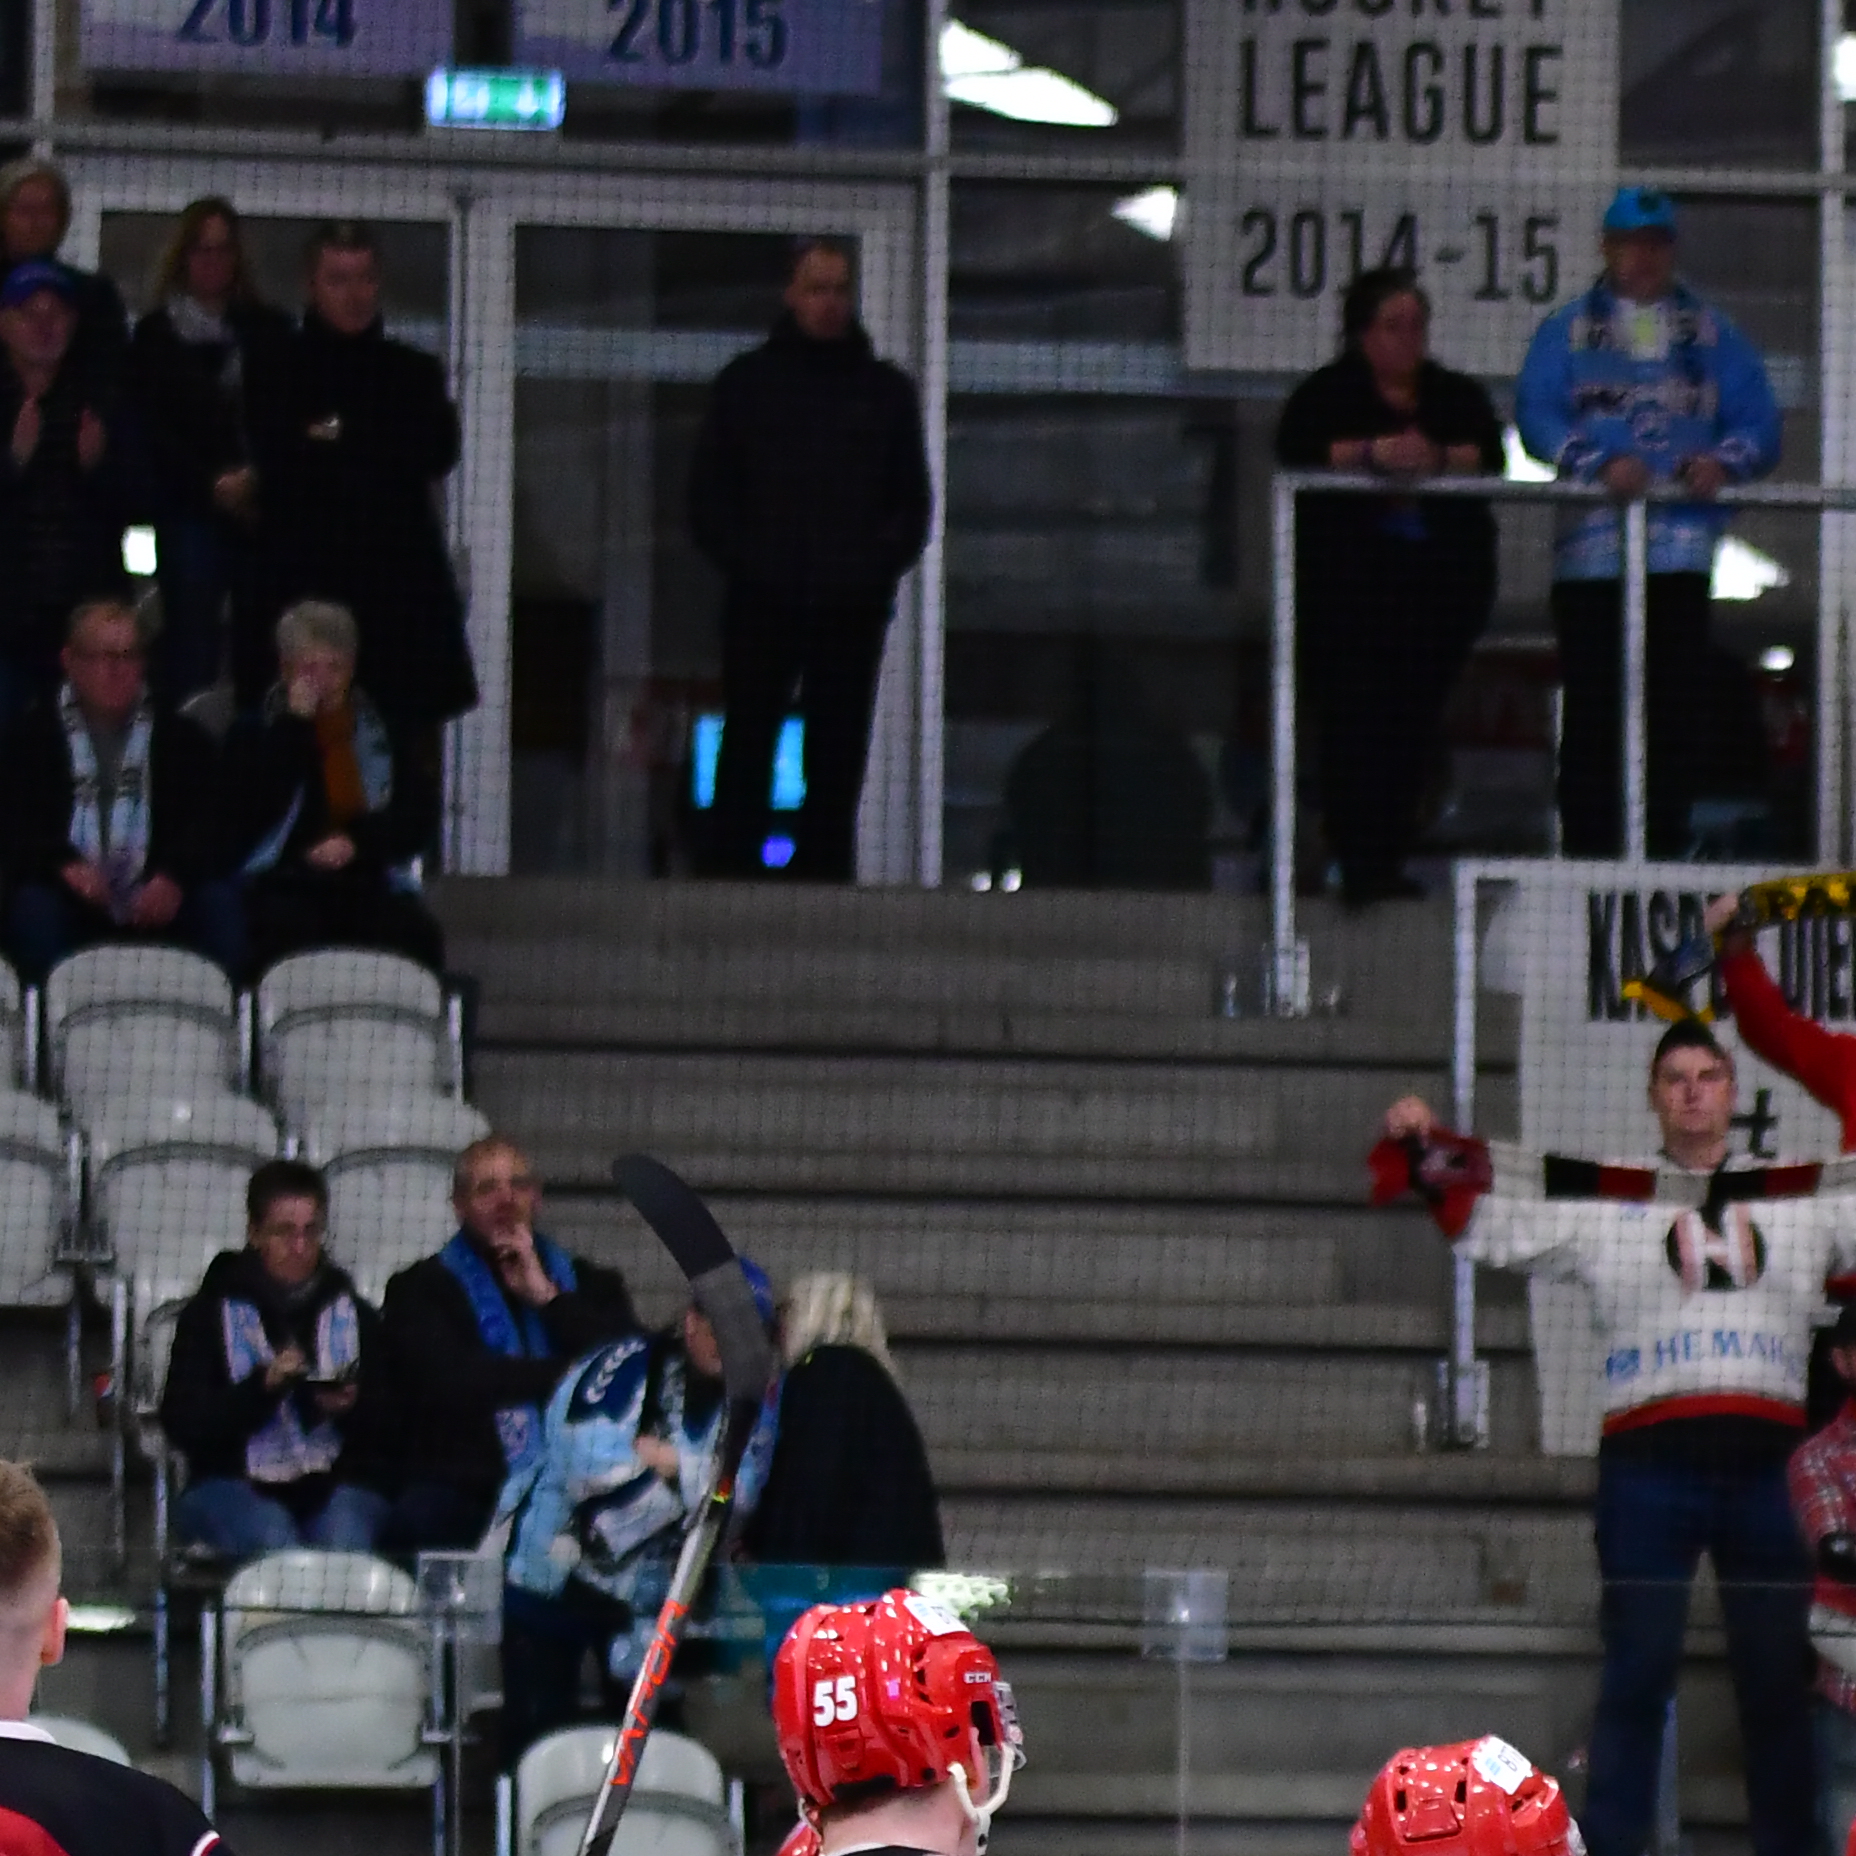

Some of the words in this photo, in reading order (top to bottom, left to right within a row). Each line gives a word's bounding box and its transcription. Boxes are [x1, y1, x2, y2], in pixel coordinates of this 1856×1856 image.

[606, 0, 789, 70] 2015
[1238, 39, 1564, 145] LEAGUE
[1241, 208, 1559, 304] 2014-15
[812, 1676, 858, 1728] 55
